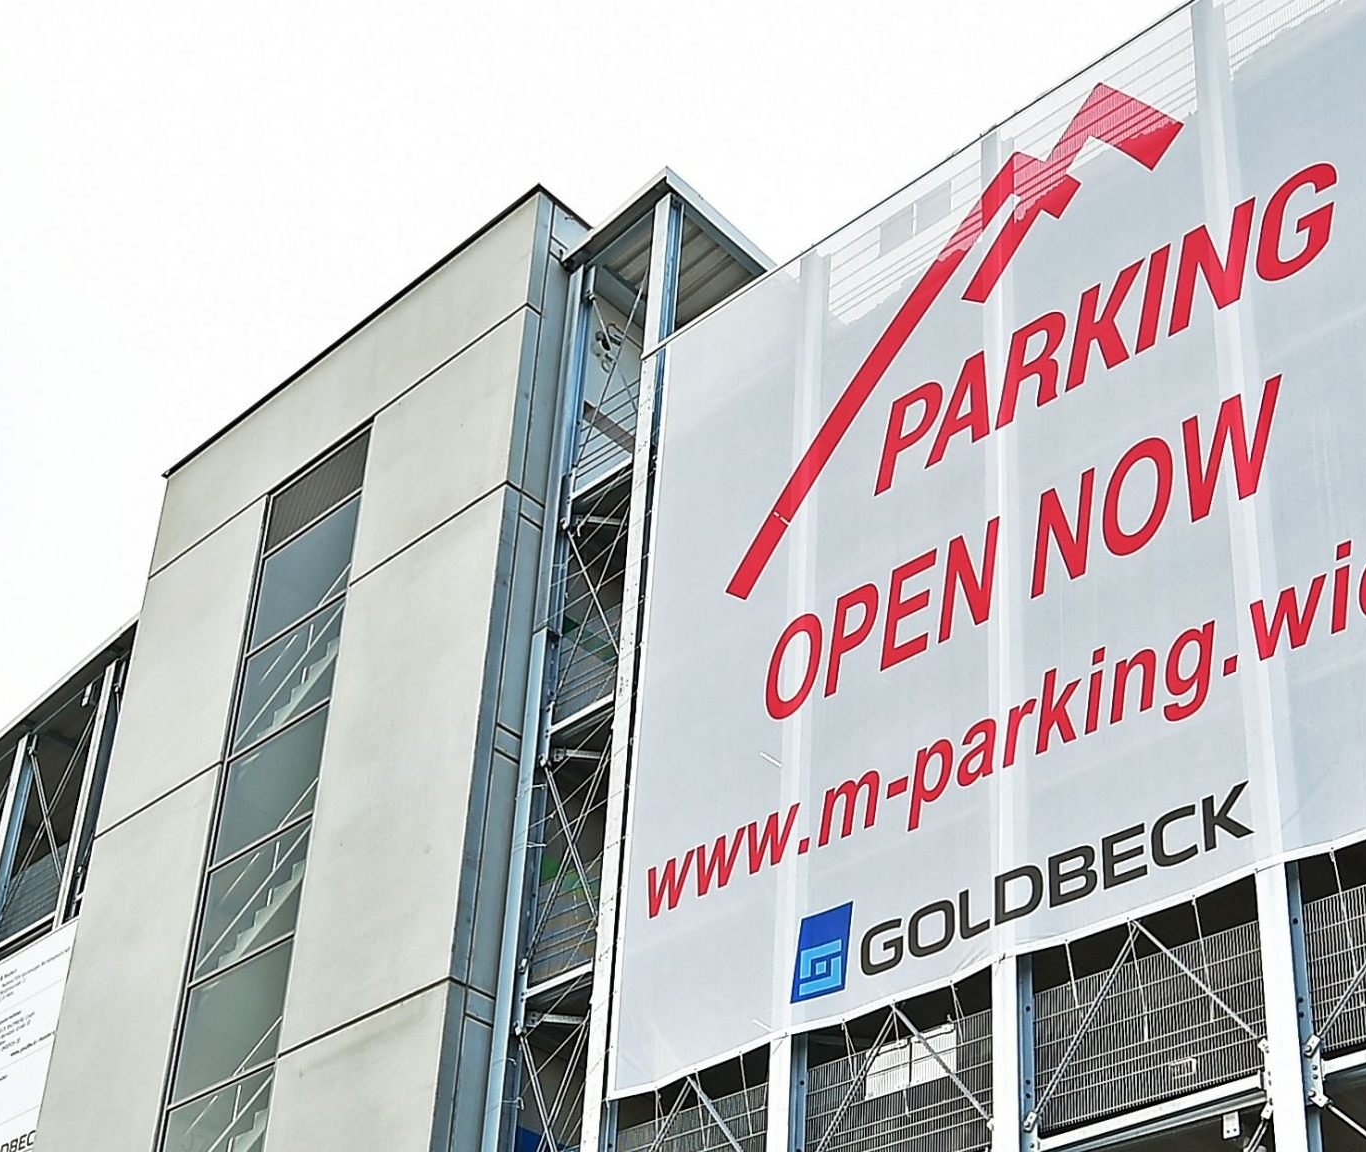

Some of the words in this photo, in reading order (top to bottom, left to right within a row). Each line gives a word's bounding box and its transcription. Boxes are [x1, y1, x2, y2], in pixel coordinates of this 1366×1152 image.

[875, 163, 1337, 496] PARKING
[766, 516, 1000, 721] OPEN
[1031, 373, 1282, 600] NOW
[860, 783, 1254, 978] GOLDBECK
